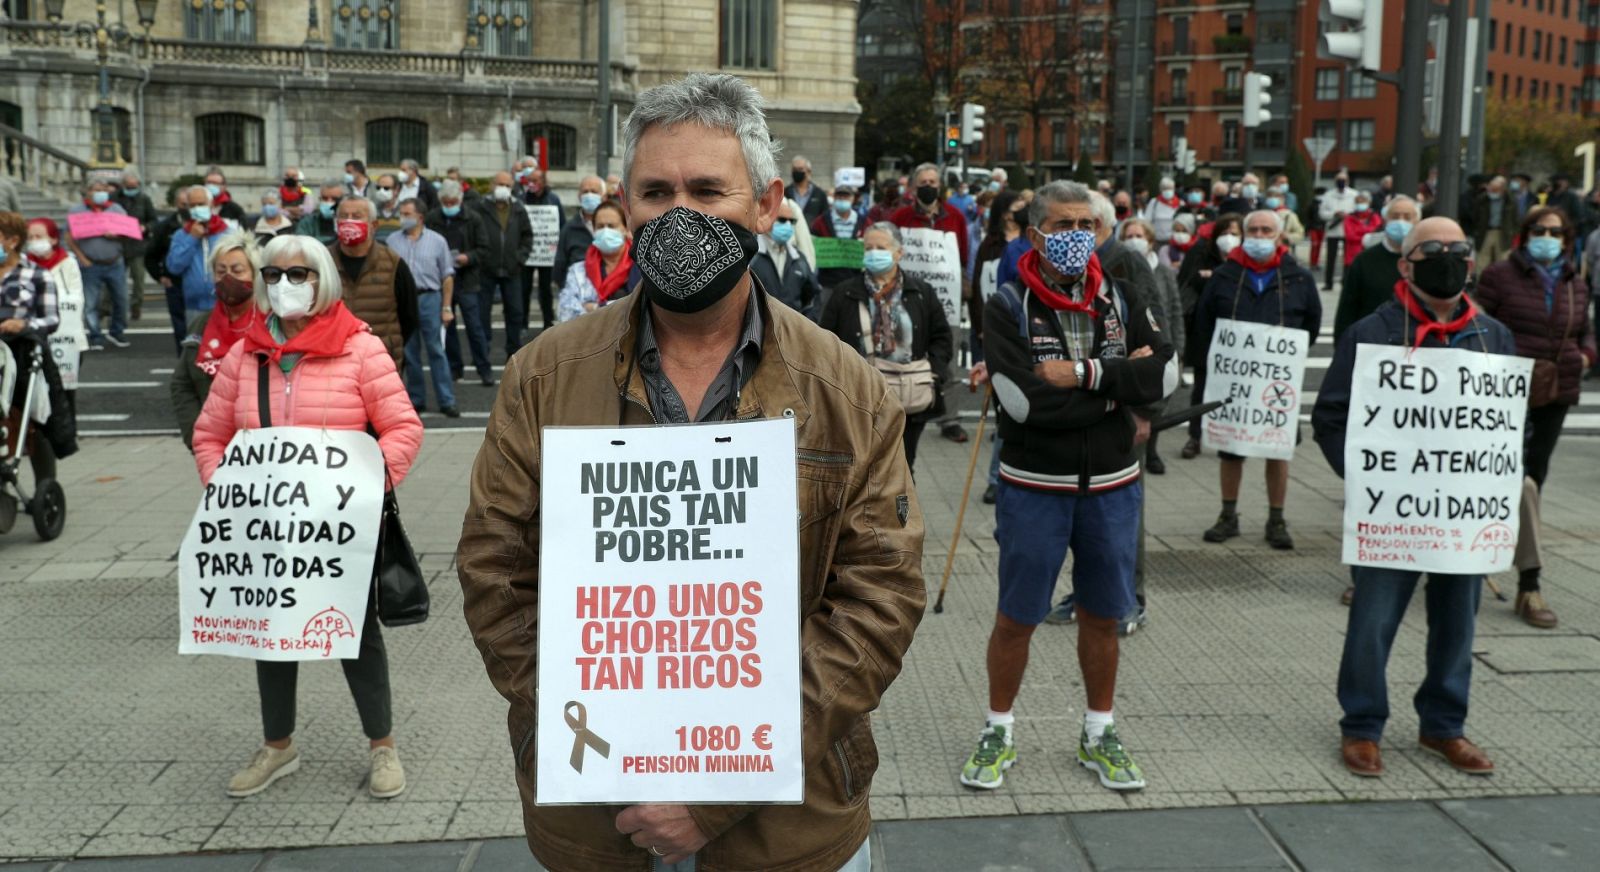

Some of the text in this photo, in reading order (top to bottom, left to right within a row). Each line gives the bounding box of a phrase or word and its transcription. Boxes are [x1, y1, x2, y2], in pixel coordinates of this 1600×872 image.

[1217, 328, 1298, 356] NO A LOS
[1214, 353, 1292, 381] RECORTES
[1378, 359, 1527, 399] RED PUBLICA
[1229, 382, 1251, 399] EN
[1363, 404, 1518, 431] Y UNIVERSAL
[1361, 443, 1517, 476] DE ATENCIÓN
[580, 456, 759, 495] NUNCA UN
[205, 475, 356, 511] PUBLICA Y
[1366, 486, 1511, 520] Y CUIDADOS
[592, 491, 747, 529] PAIS TAN
[199, 512, 356, 546] DE CALIDAD
[1356, 535, 1448, 551] PENSIONISTAS
[1357, 521, 1446, 538] MOVIMIENTO
[595, 528, 744, 563] POBRE...
[1357, 550, 1417, 563] BIZKAIA
[196, 552, 344, 579] PARA TODAS
[200, 586, 297, 609] Y TODOS
[576, 581, 764, 619] HIZO UNOS
[194, 614, 270, 631] MOVIMIENTO DE
[314, 616, 344, 629] MPB
[581, 617, 757, 655] CHORIZOS
[192, 630, 332, 651] PENSIONISTAS DE BIZKAIA
[576, 653, 762, 691] TAN RICOS
[675, 724, 773, 752] 1080 €
[622, 754, 774, 774] PENSION MINIMA
